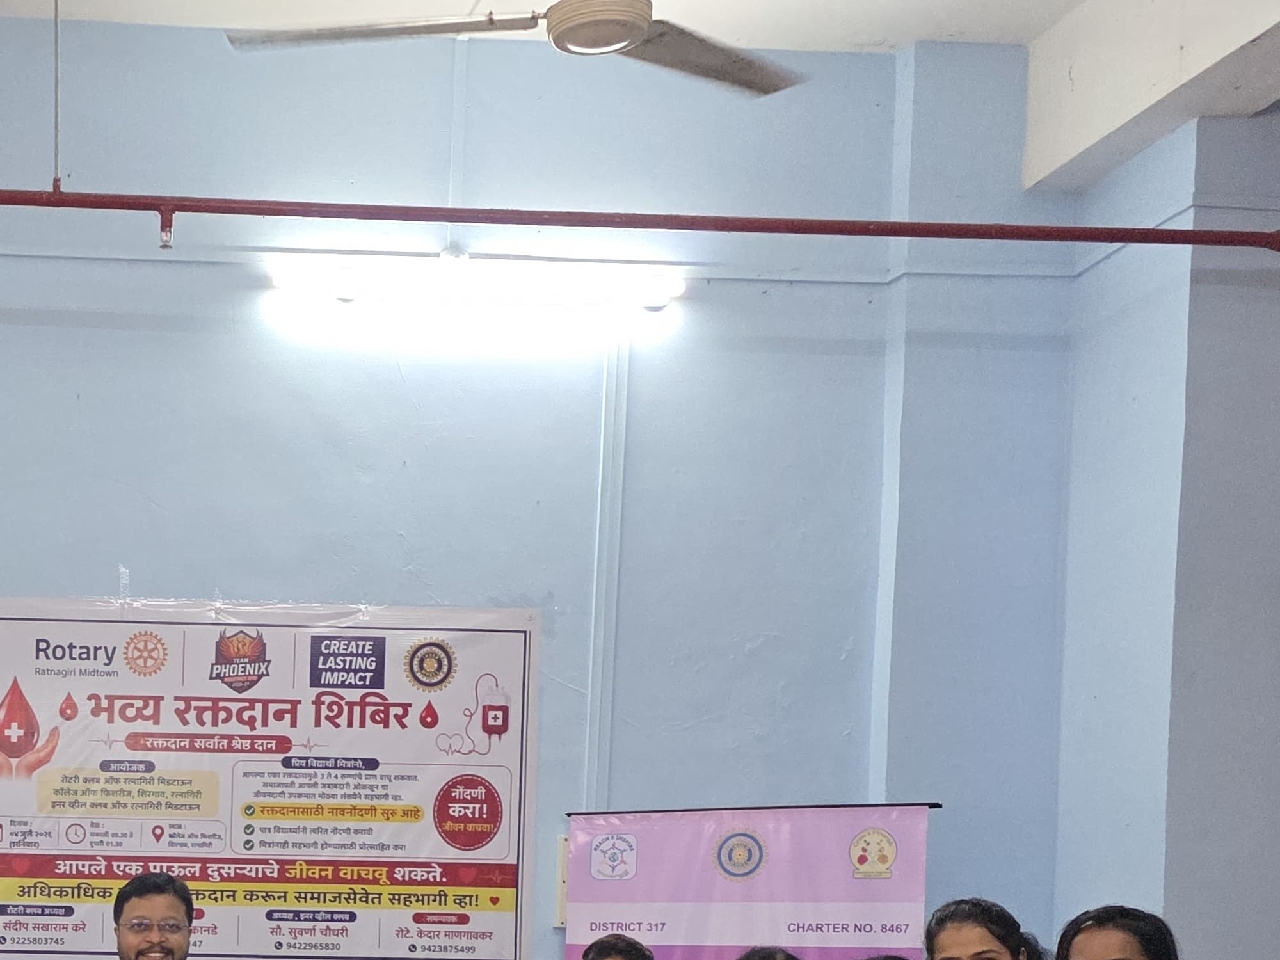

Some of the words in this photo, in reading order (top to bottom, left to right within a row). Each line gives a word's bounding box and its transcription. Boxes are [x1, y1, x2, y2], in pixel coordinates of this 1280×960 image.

[35, 639, 117, 666] Rotary
[321, 641, 373, 654] CREATE
[212, 662, 268, 677] PHOENIX
[318, 656, 377, 670] LASTING
[35, 668, 76, 678] Ratnagiri
[79, 669, 118, 677] Midtown
[321, 671, 373, 685] IMPACT
[87, 693, 165, 726] भव्य
[174, 696, 302, 731] रक्तदान
[312, 691, 413, 730] शिबिर
[145, 737, 189, 749] रक्तदान
[254, 739, 276, 750] दान
[109, 761, 146, 771] आयोजक
[60, 774, 80, 784] रोटरी
[123, 776, 155, 786] रत्नागिरी
[171, 790, 203, 800] रत्नागिरी
[451, 785, 486, 800] नोंदणी
[130, 801, 162, 811] रत्नागिरी
[259, 804, 325, 817] रक्तदानासाठी
[400, 806, 420, 820] आहे
[448, 804, 487, 818] करा!
[442, 820, 464, 832] जीवन
[54, 856, 108, 875] आपले
[112, 861, 144, 875] एक
[285, 861, 333, 880] जीवन
[339, 866, 390, 885] वाचवू
[393, 864, 448, 882] शकते.
[16, 881, 113, 899] अधिकाधिक
[242, 891, 289, 904] करून
[293, 888, 384, 906] समाजसेवेत
[388, 890, 448, 907] सहभागी
[452, 893, 480, 908] व्हा!
[3, 920, 29, 932] संदीप
[32, 923, 68, 932] सखाराम
[72, 921, 87, 932] करे
[269, 923, 285, 936] सौ.
[288, 924, 317, 939] सुवर्णा
[590, 922, 643, 932] DISTRICT
[646, 922, 667, 932] 317
[787, 923, 849, 933] CHARTER
[853, 923, 877, 934] NO.
[880, 923, 910, 934] 8467
[395, 927, 413, 939] रोटे.
[417, 927, 440, 940] केदार
[10, 937, 65, 945] 9225803745
[286, 942, 341, 951] 9422965830
[420, 945, 476, 953] 9423875499
